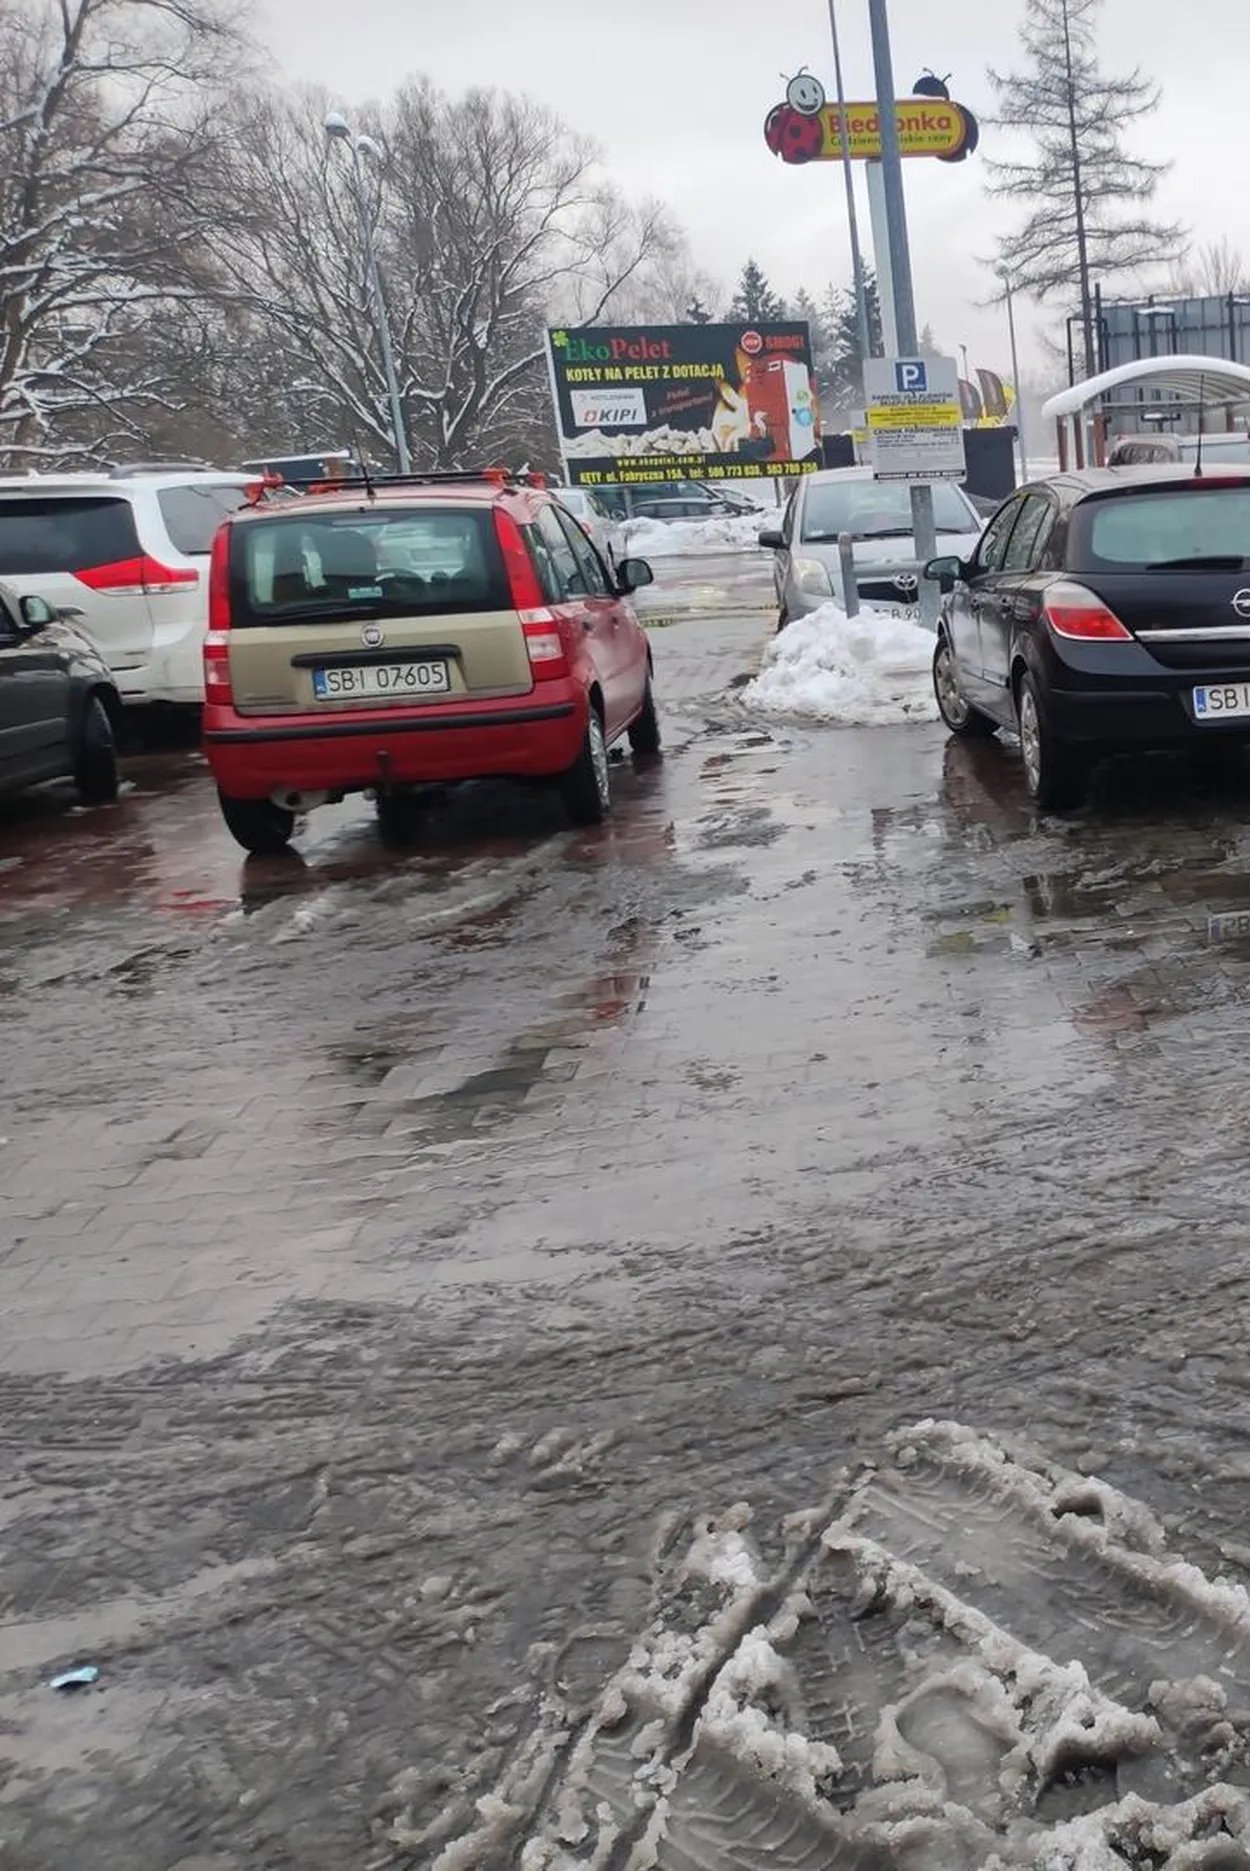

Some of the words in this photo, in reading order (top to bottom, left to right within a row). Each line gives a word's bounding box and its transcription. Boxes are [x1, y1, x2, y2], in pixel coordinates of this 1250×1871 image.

[828, 112, 951, 134] Biedonka
[566, 335, 673, 360] EkoPelet
[565, 367, 601, 382] KOTŁY
[605, 366, 623, 380] NA
[625, 365, 659, 380] PELET
[661, 364, 671, 379] Z
[672, 362, 725, 379] DOTACJĄ
[902, 365, 919, 389] P
[326, 669, 365, 692] SBI
[376, 663, 444, 689] 07605
[1208, 686, 1250, 710] SBI
